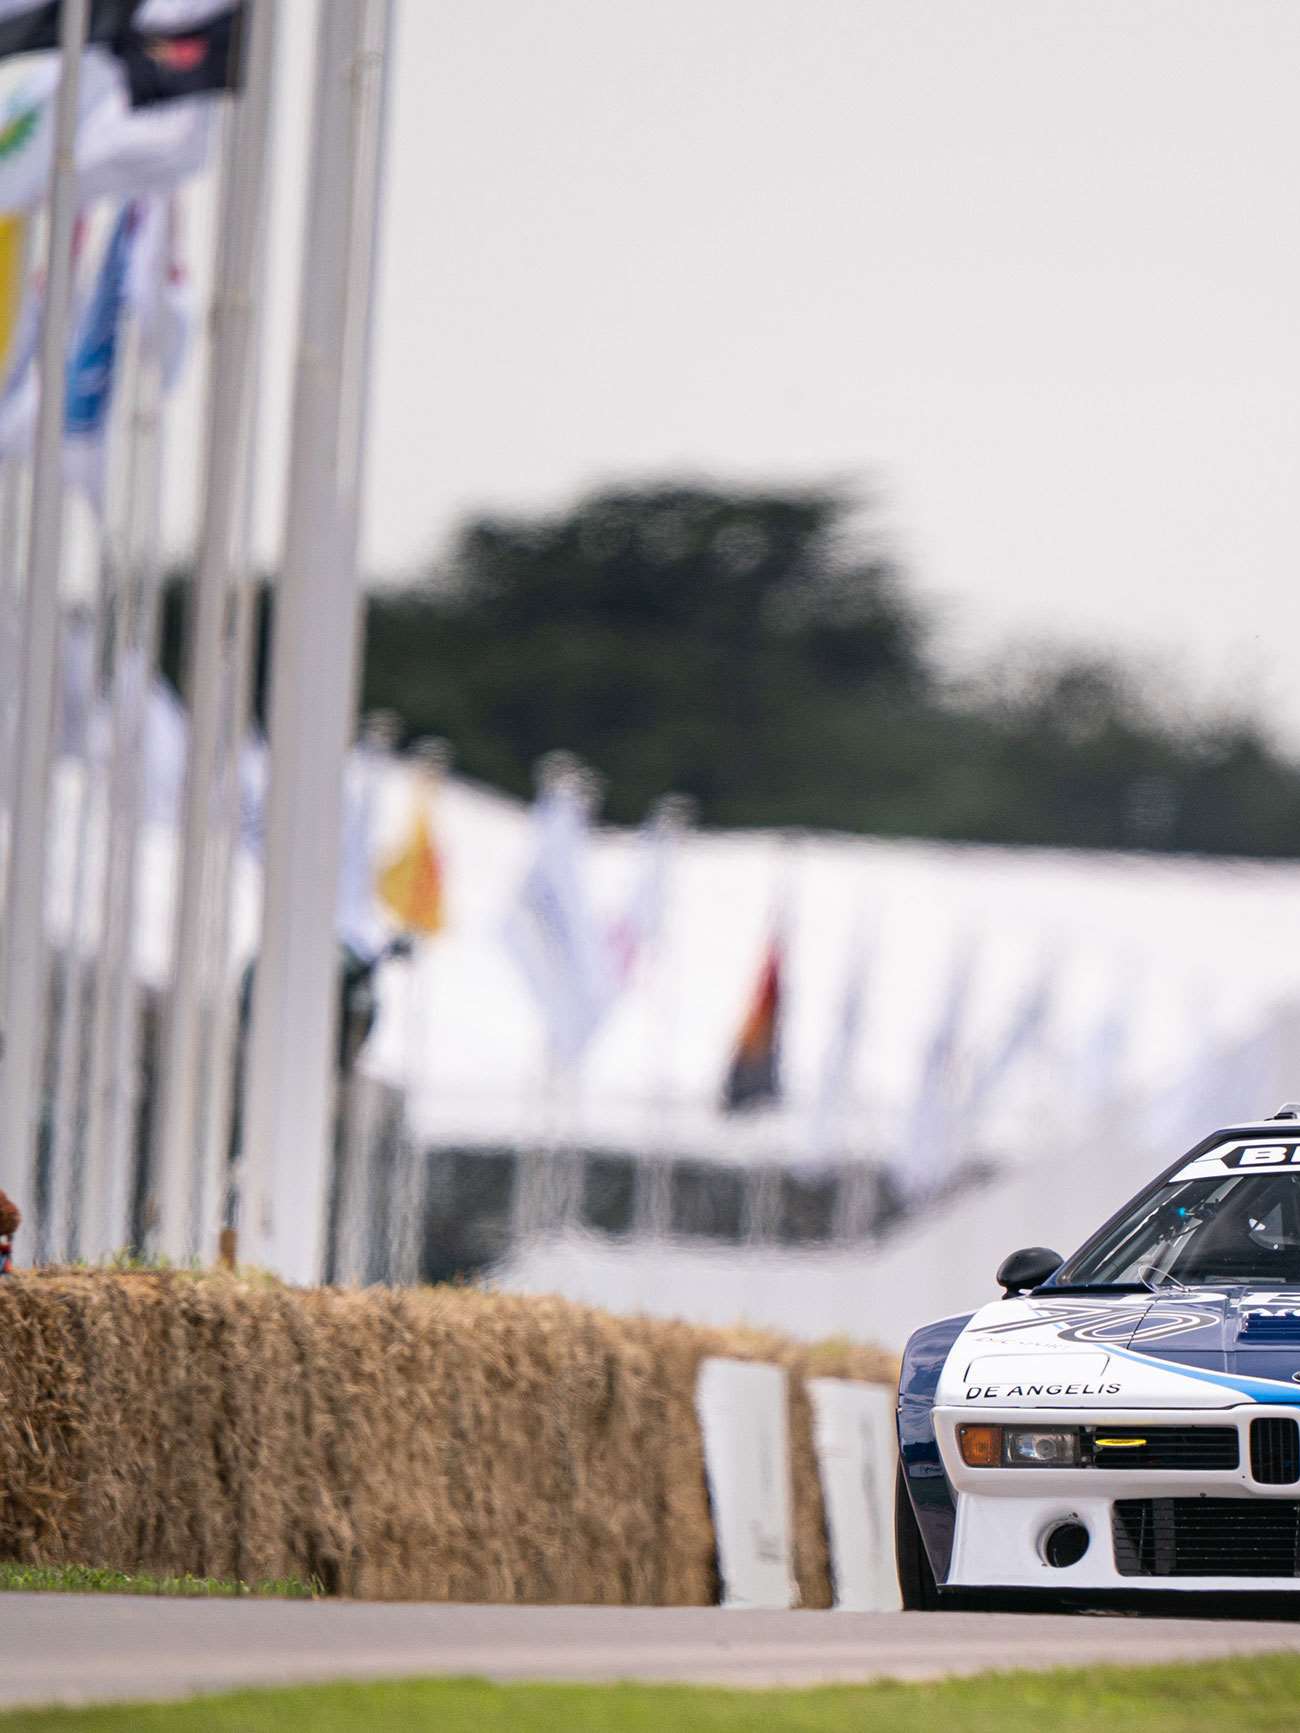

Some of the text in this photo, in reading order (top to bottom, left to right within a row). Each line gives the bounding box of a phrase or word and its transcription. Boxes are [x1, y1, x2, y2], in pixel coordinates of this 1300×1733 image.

[966, 1303, 1222, 1344] 70
[965, 1383, 1122, 1400] DE ANGELIS
